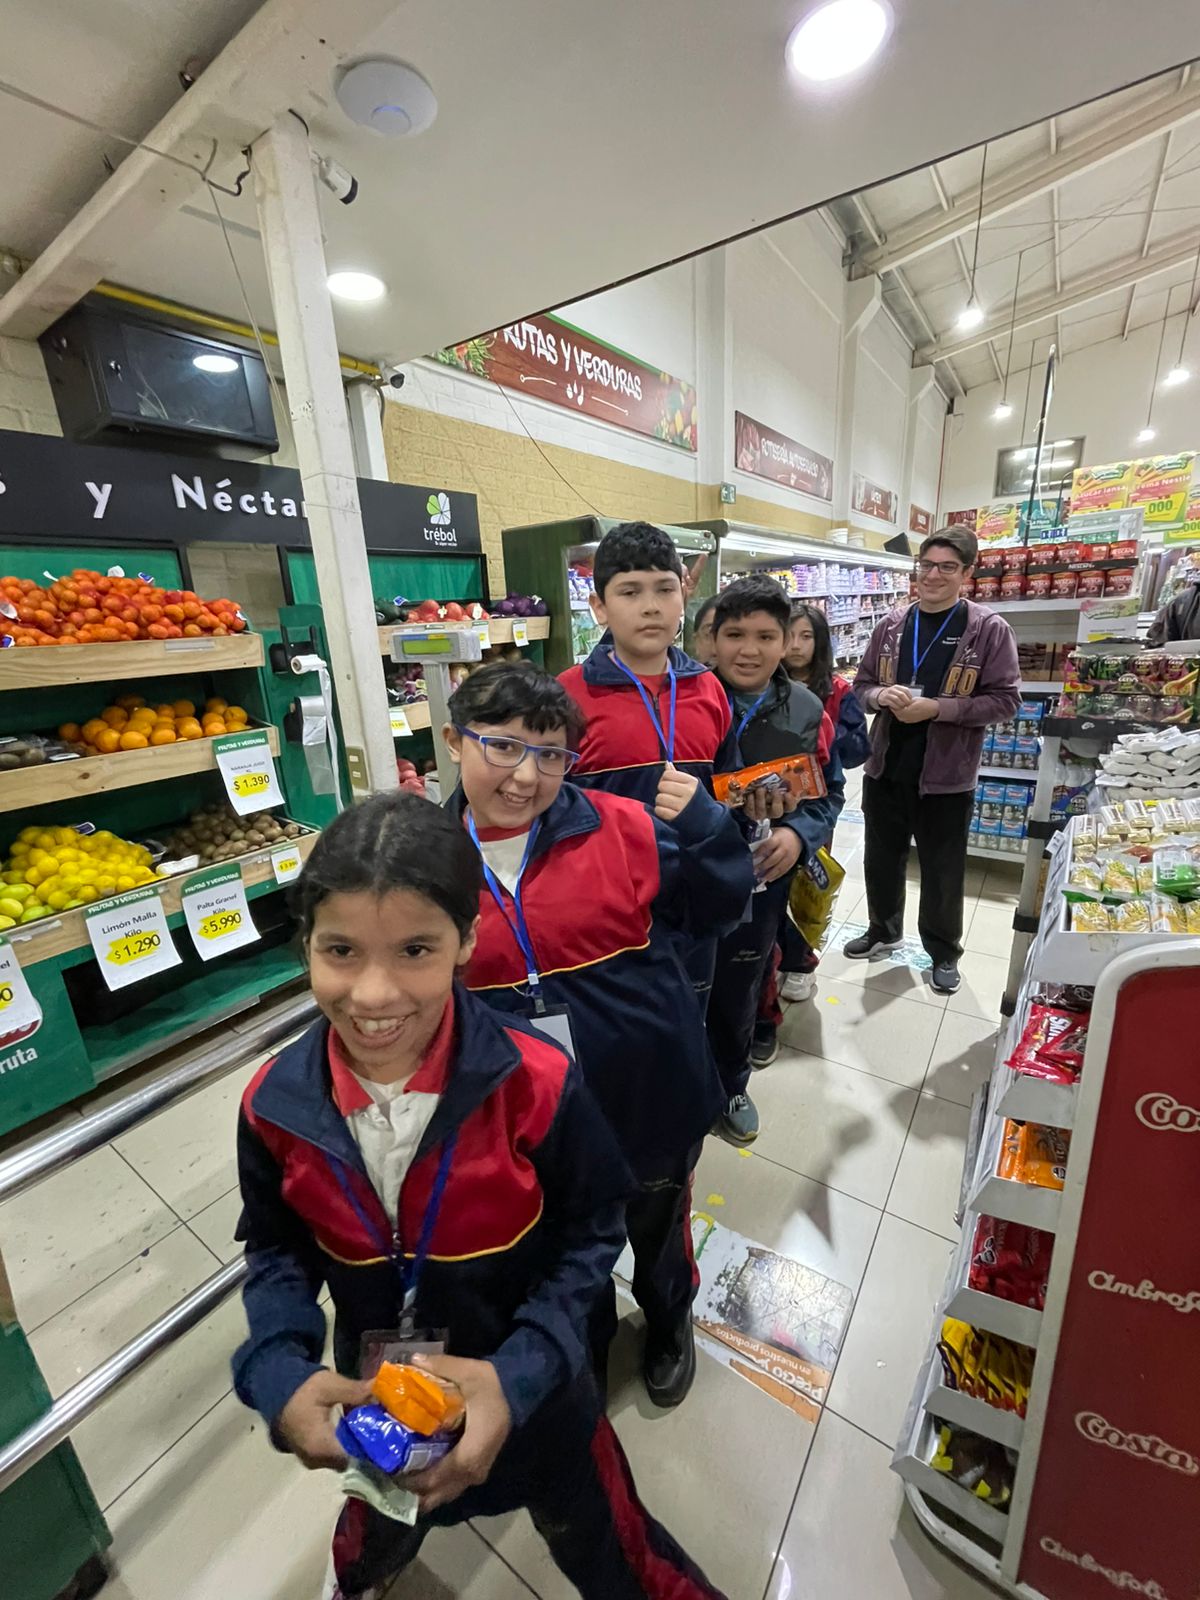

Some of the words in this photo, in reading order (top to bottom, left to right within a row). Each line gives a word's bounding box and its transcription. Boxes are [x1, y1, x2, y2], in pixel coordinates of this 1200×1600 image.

[500, 321, 558, 365] RUTAS
[561, 338, 570, 371] Y
[574, 346, 642, 401] VERDURAS
[85, 482, 112, 518] y
[424, 528, 457, 542] trébol
[234, 780, 240, 791] $
[243, 774, 270, 788] 1.390
[197, 901, 214, 910] Palta
[216, 894, 237, 904] Granel
[102, 920, 131, 934] Limón
[132, 911, 157, 924] Malla
[124, 928, 142, 939] Kilo
[203, 925, 208, 934] $
[210, 912, 242, 932] 5.990
[114, 950, 121, 960] $
[124, 934, 160, 956] 1.290
[716, 1328, 760, 1351] productos
[760, 1350, 798, 1370] nuestros
